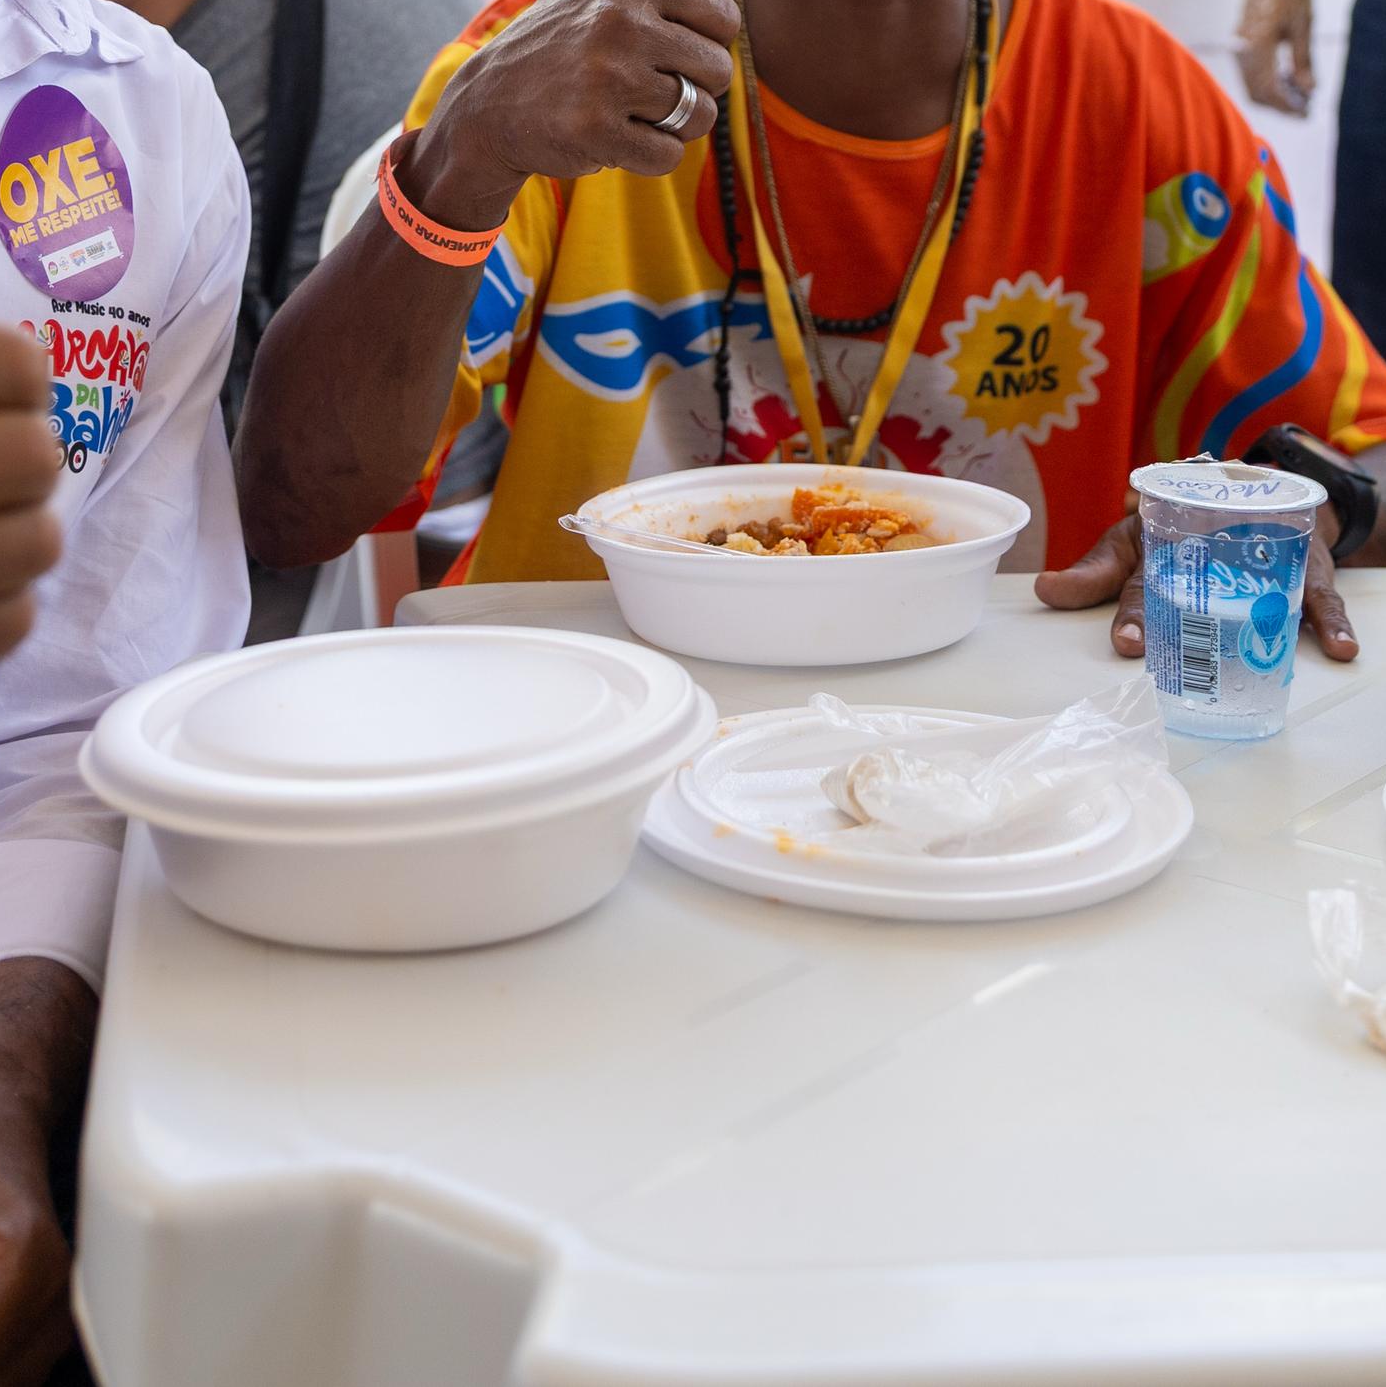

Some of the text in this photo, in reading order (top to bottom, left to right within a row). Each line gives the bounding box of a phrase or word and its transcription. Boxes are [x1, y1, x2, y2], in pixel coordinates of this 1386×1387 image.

[9, 188, 123, 249] ME RESPEITE!
[398, 207, 414, 227] NO
[415, 223, 494, 252] ALIMENTAR
[75, 300, 106, 317] Music
[108, 306, 125, 319] 40
[127, 309, 151, 328] anos
[993, 322, 1051, 366] 20
[975, 365, 1060, 399] ANOS
[76, 383, 100, 411] DA
